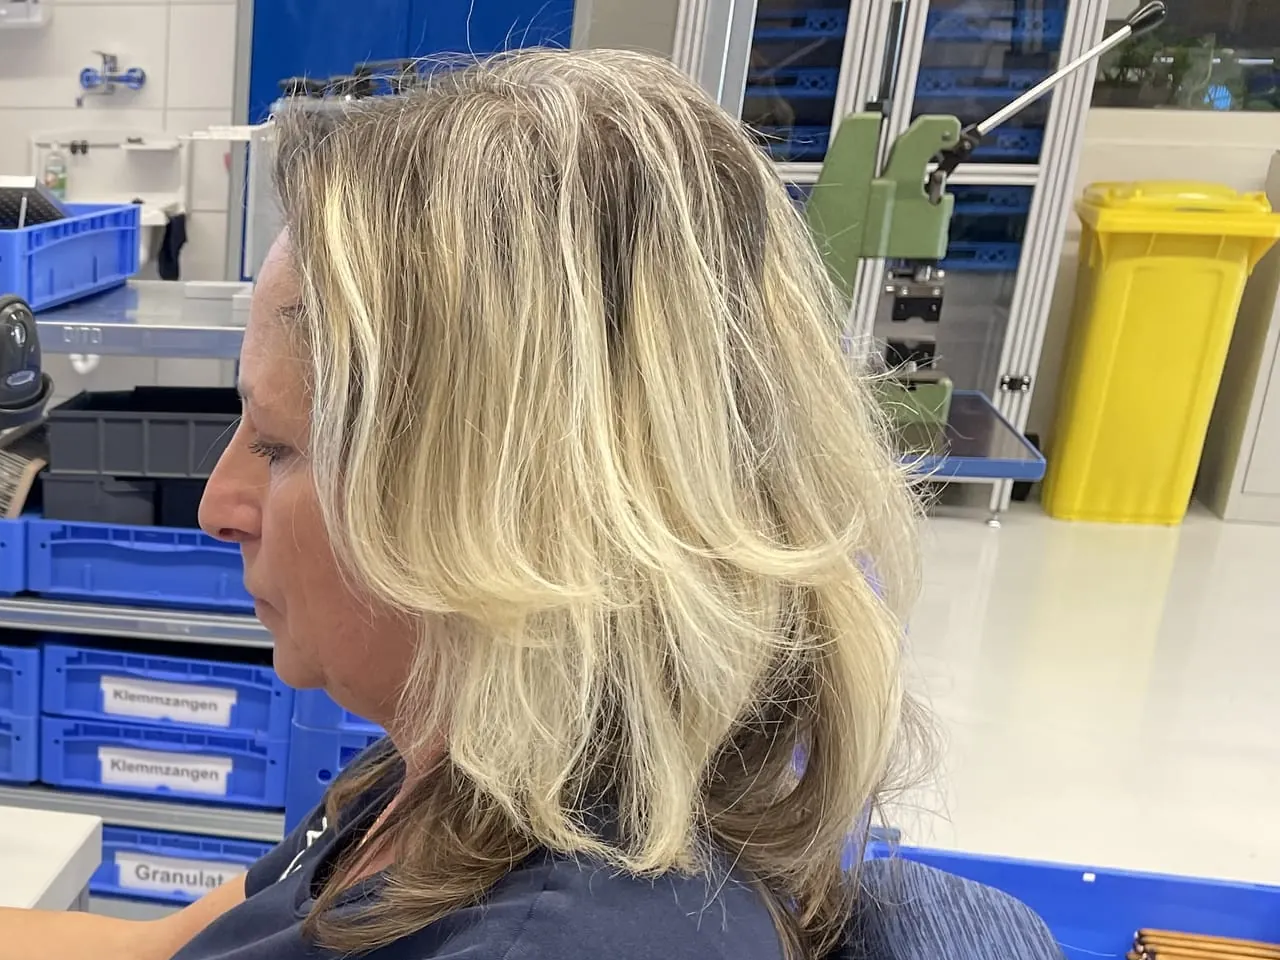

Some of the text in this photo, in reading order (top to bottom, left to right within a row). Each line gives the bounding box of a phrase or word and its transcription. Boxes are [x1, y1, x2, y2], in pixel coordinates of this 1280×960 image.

[113, 689, 219, 712] Klemmzangen
[111, 759, 220, 782] Klemmzangen
[135, 864, 224, 888] Granulat
